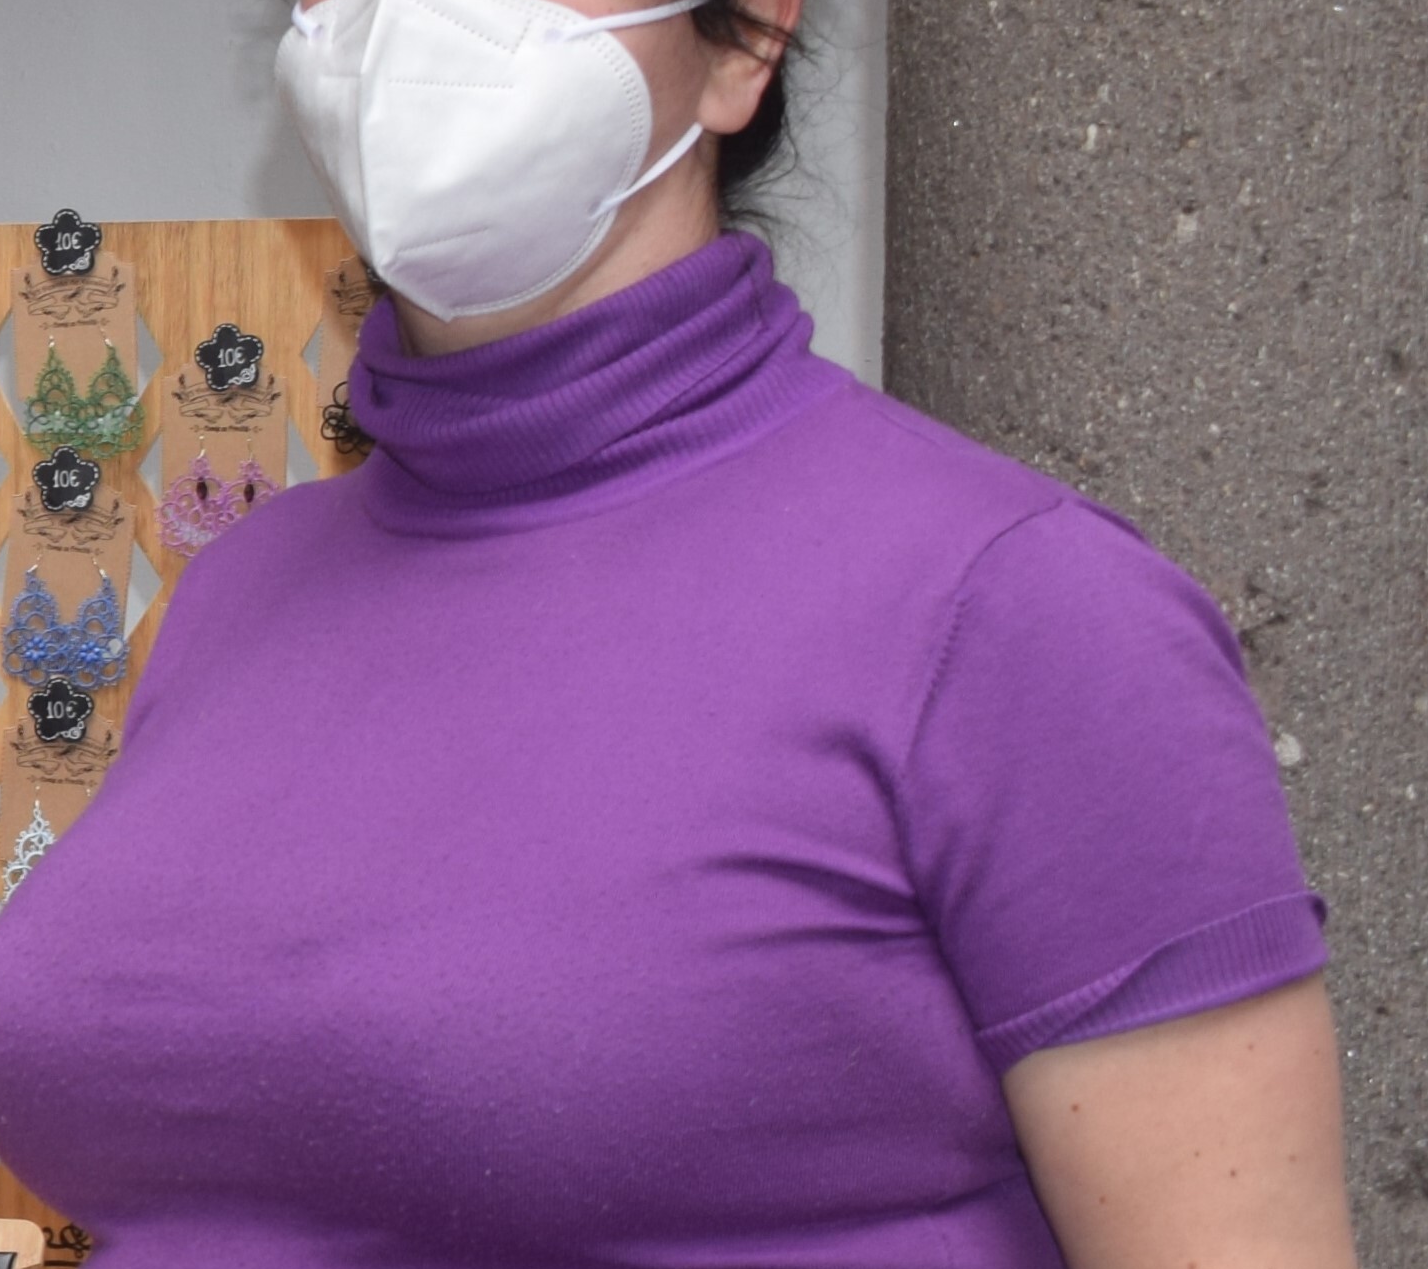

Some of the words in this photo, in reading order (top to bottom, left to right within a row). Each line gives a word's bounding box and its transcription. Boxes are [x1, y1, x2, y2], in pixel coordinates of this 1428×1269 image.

[54, 230, 82, 252] 10€
[216, 345, 246, 369] 10€
[52, 468, 80, 489] 10€
[46, 700, 77, 720] 10€
